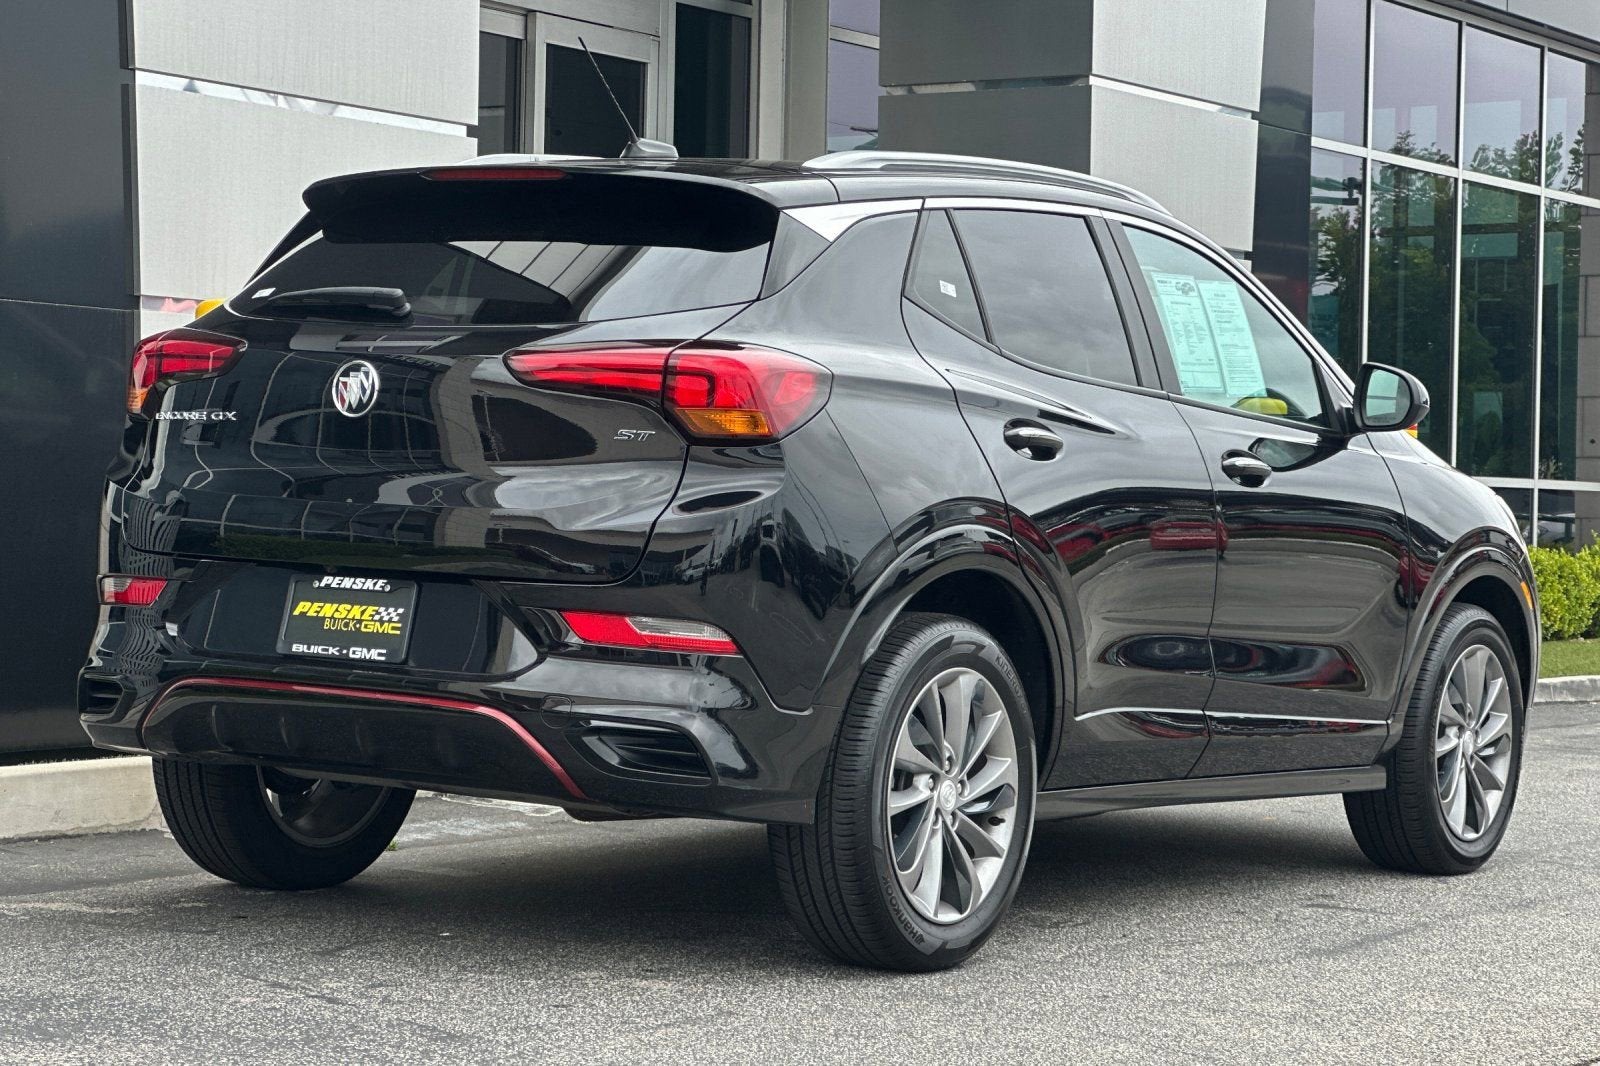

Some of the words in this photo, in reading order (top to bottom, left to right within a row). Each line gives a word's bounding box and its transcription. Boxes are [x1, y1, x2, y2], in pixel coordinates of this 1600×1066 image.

[155, 411, 207, 421] ENCORE
[211, 411, 237, 421] GX
[613, 429, 656, 441] ST
[319, 576, 388, 591] PENSKE
[292, 601, 379, 620] PENSKE
[323, 618, 356, 632] BUICK
[360, 621, 402, 635] GMC
[291, 643, 340, 656] BUICK
[348, 647, 387, 661] GMC
